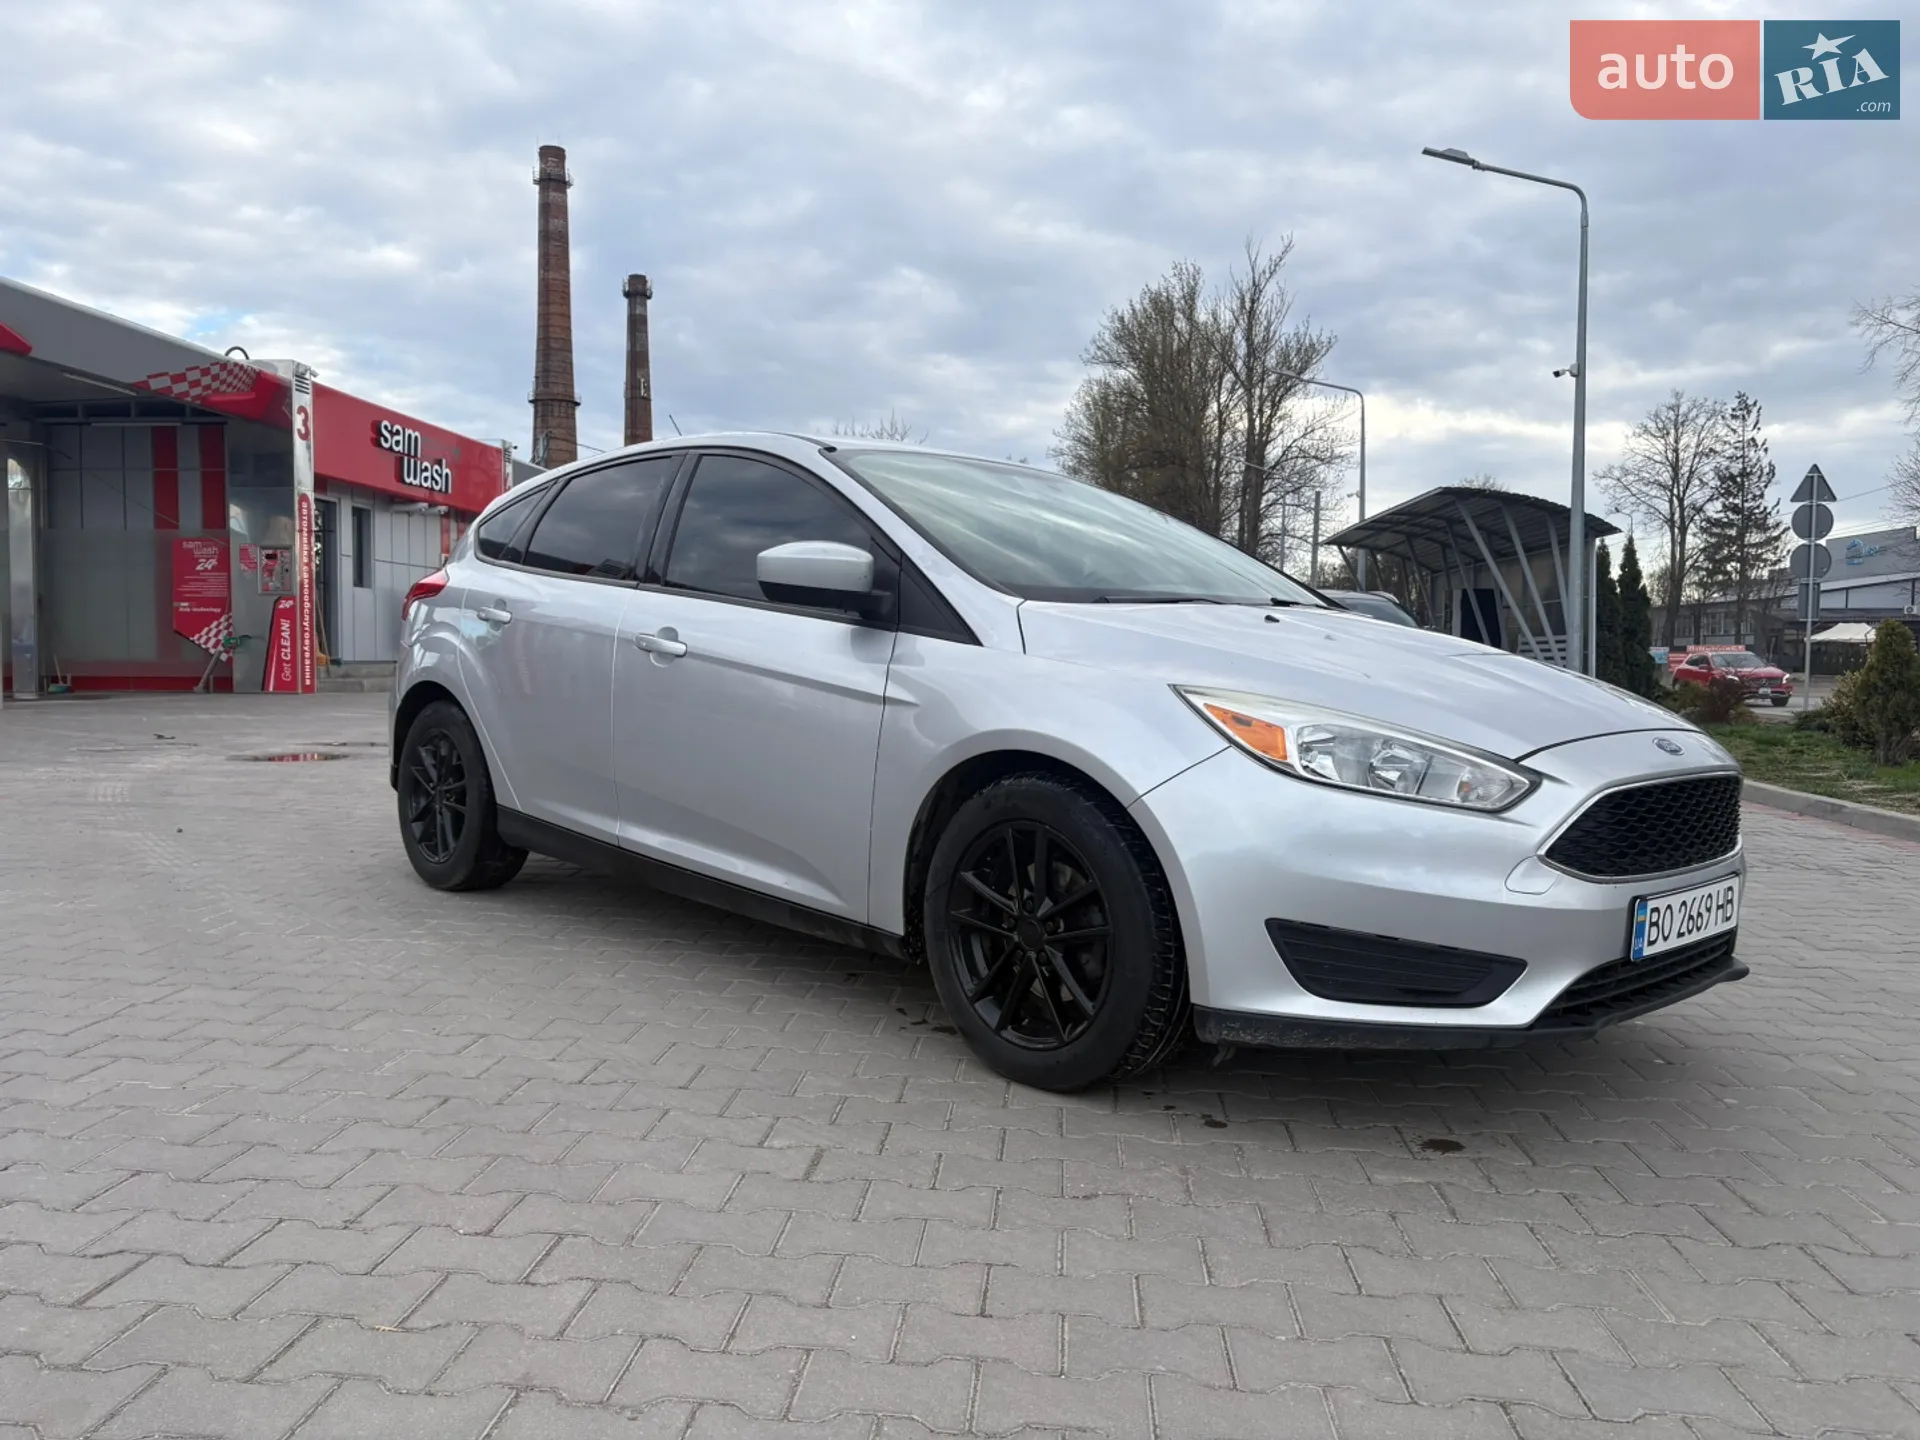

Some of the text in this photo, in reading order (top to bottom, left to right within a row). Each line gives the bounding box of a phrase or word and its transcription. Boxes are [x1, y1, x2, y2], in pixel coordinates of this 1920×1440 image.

[296, 405, 310, 441] 3
[380, 420, 422, 458] sam
[403, 455, 452, 494] wash
[280, 618, 292, 682] Get CLEAN!
[1647, 885, 1734, 947] BO 2669 HB
